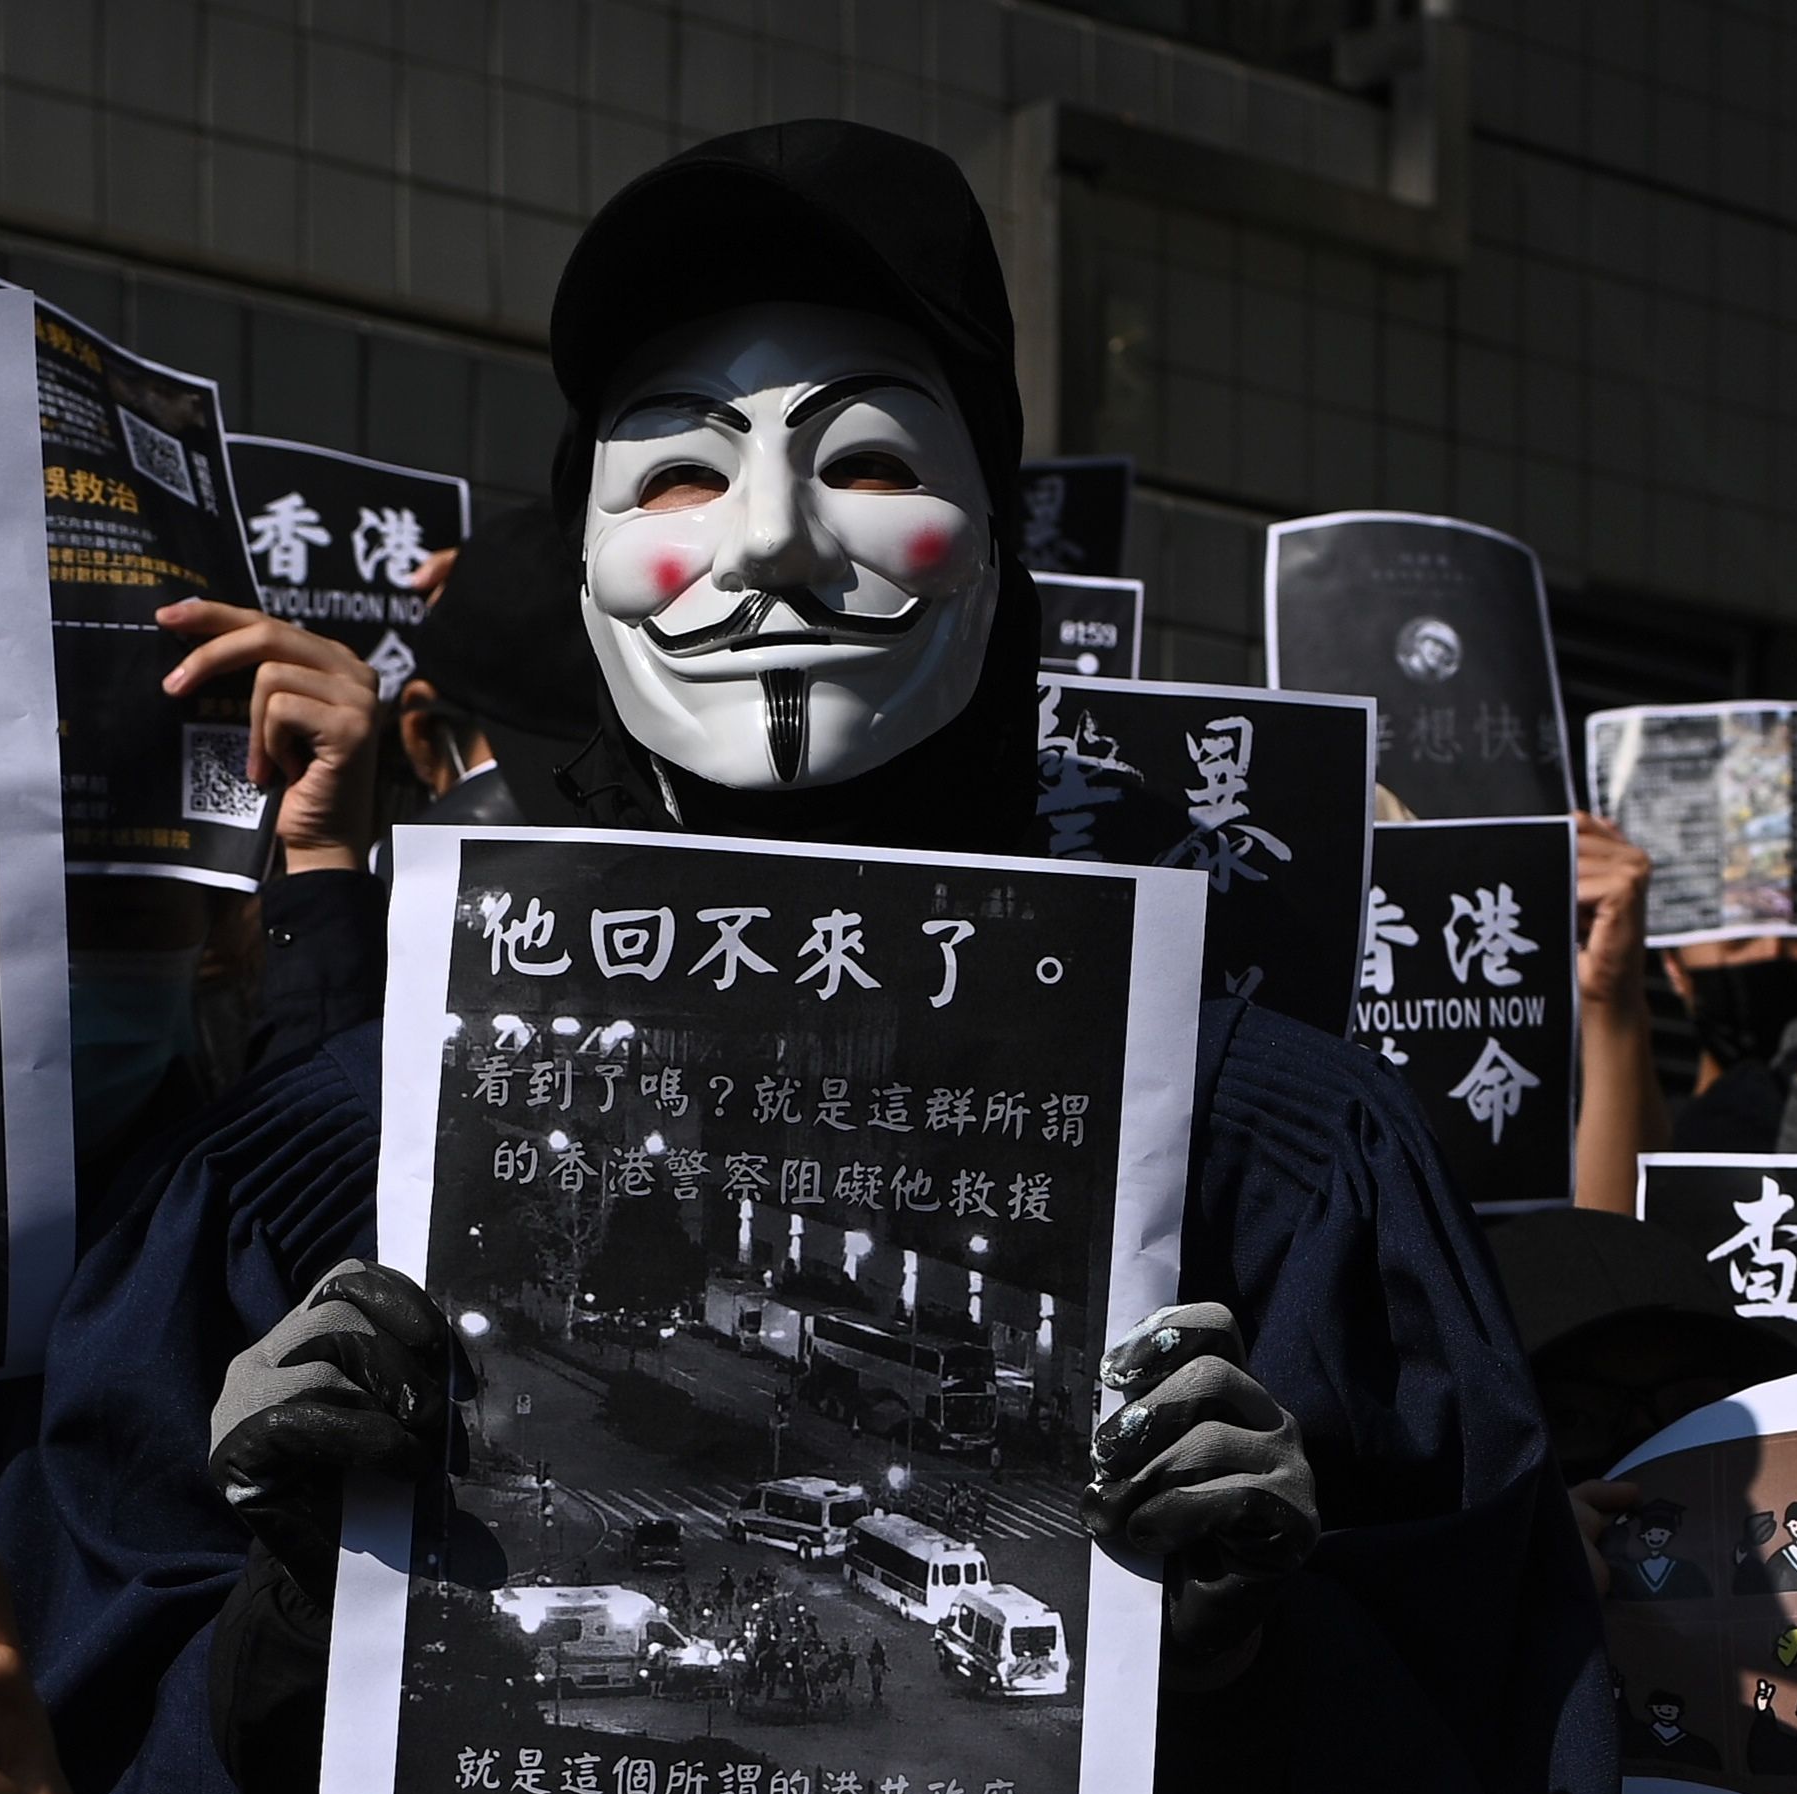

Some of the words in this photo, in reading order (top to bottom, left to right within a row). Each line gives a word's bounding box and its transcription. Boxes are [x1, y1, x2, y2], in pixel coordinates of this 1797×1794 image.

[249, 491, 432, 589] 香港
[389, 595, 429, 625] NO
[484, 891, 1064, 1008] 他回不來了。
[1353, 996, 1482, 1033] VOLUTION
[1488, 995, 1547, 1028] NOW
[493, 1138, 1055, 1225] 的香港警察阻礙他救援
